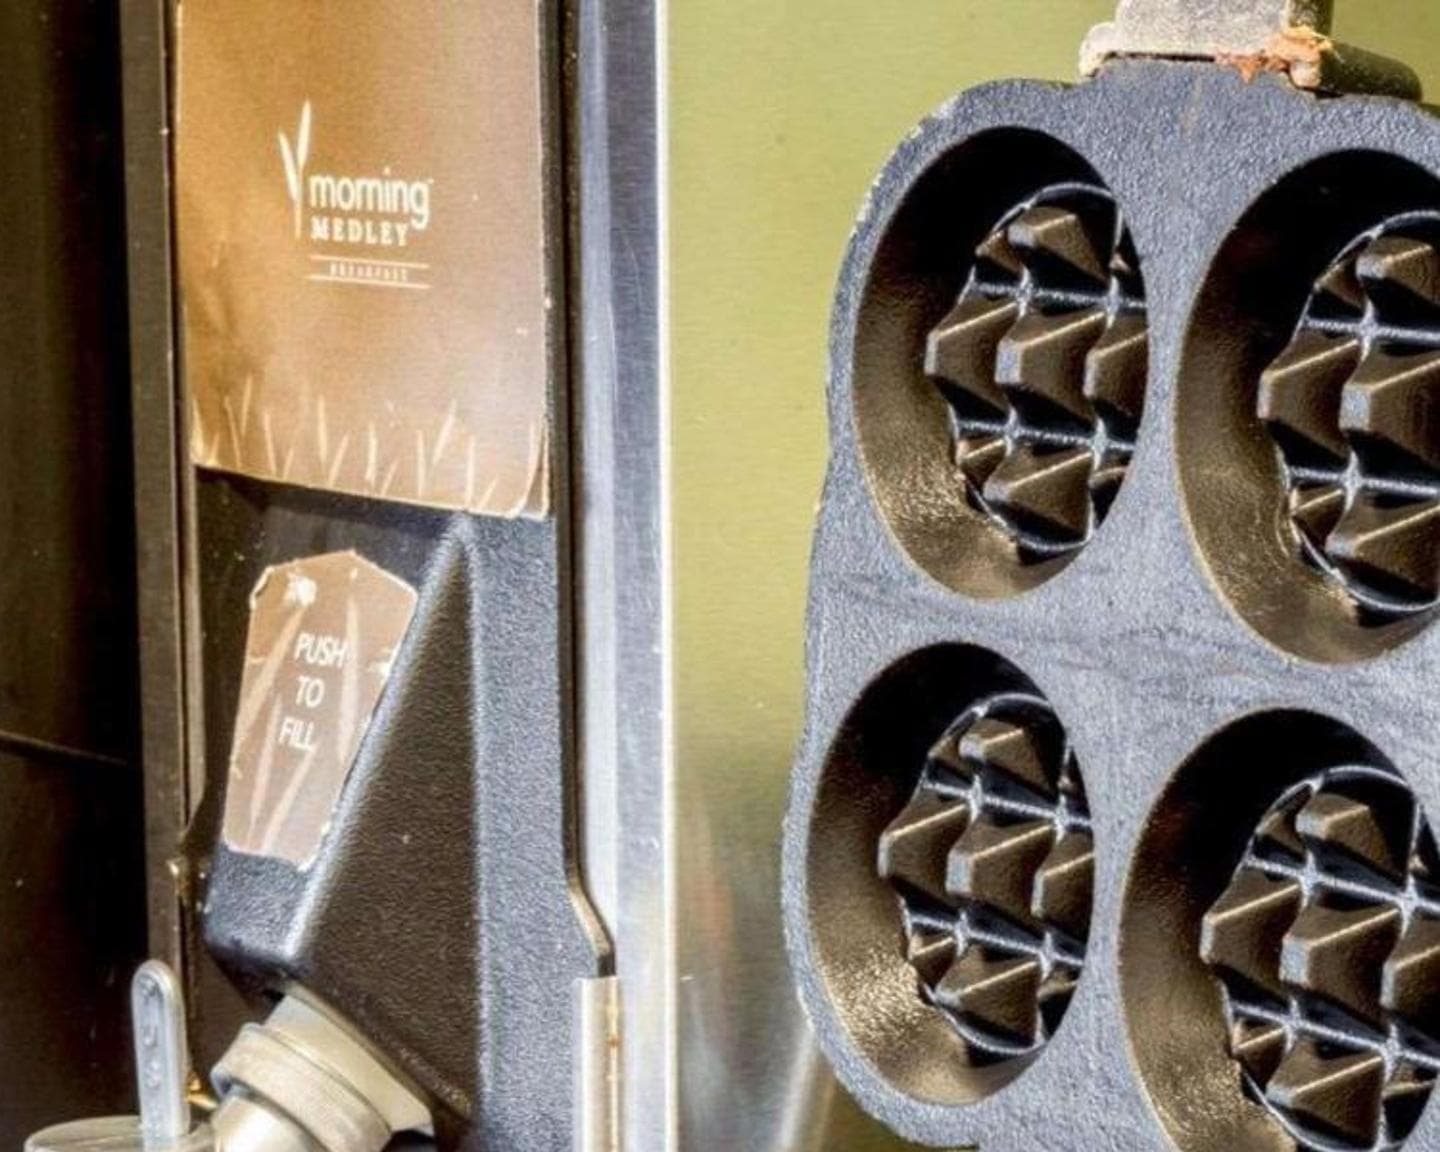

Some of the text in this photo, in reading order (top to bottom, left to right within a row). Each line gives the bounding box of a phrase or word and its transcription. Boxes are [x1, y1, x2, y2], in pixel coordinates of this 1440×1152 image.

[309, 166, 430, 231] morning
[311, 214, 409, 247] MEDLEY
[294, 633, 347, 668] PUSH
[295, 675, 325, 708] TO
[278, 716, 315, 750] FILL
